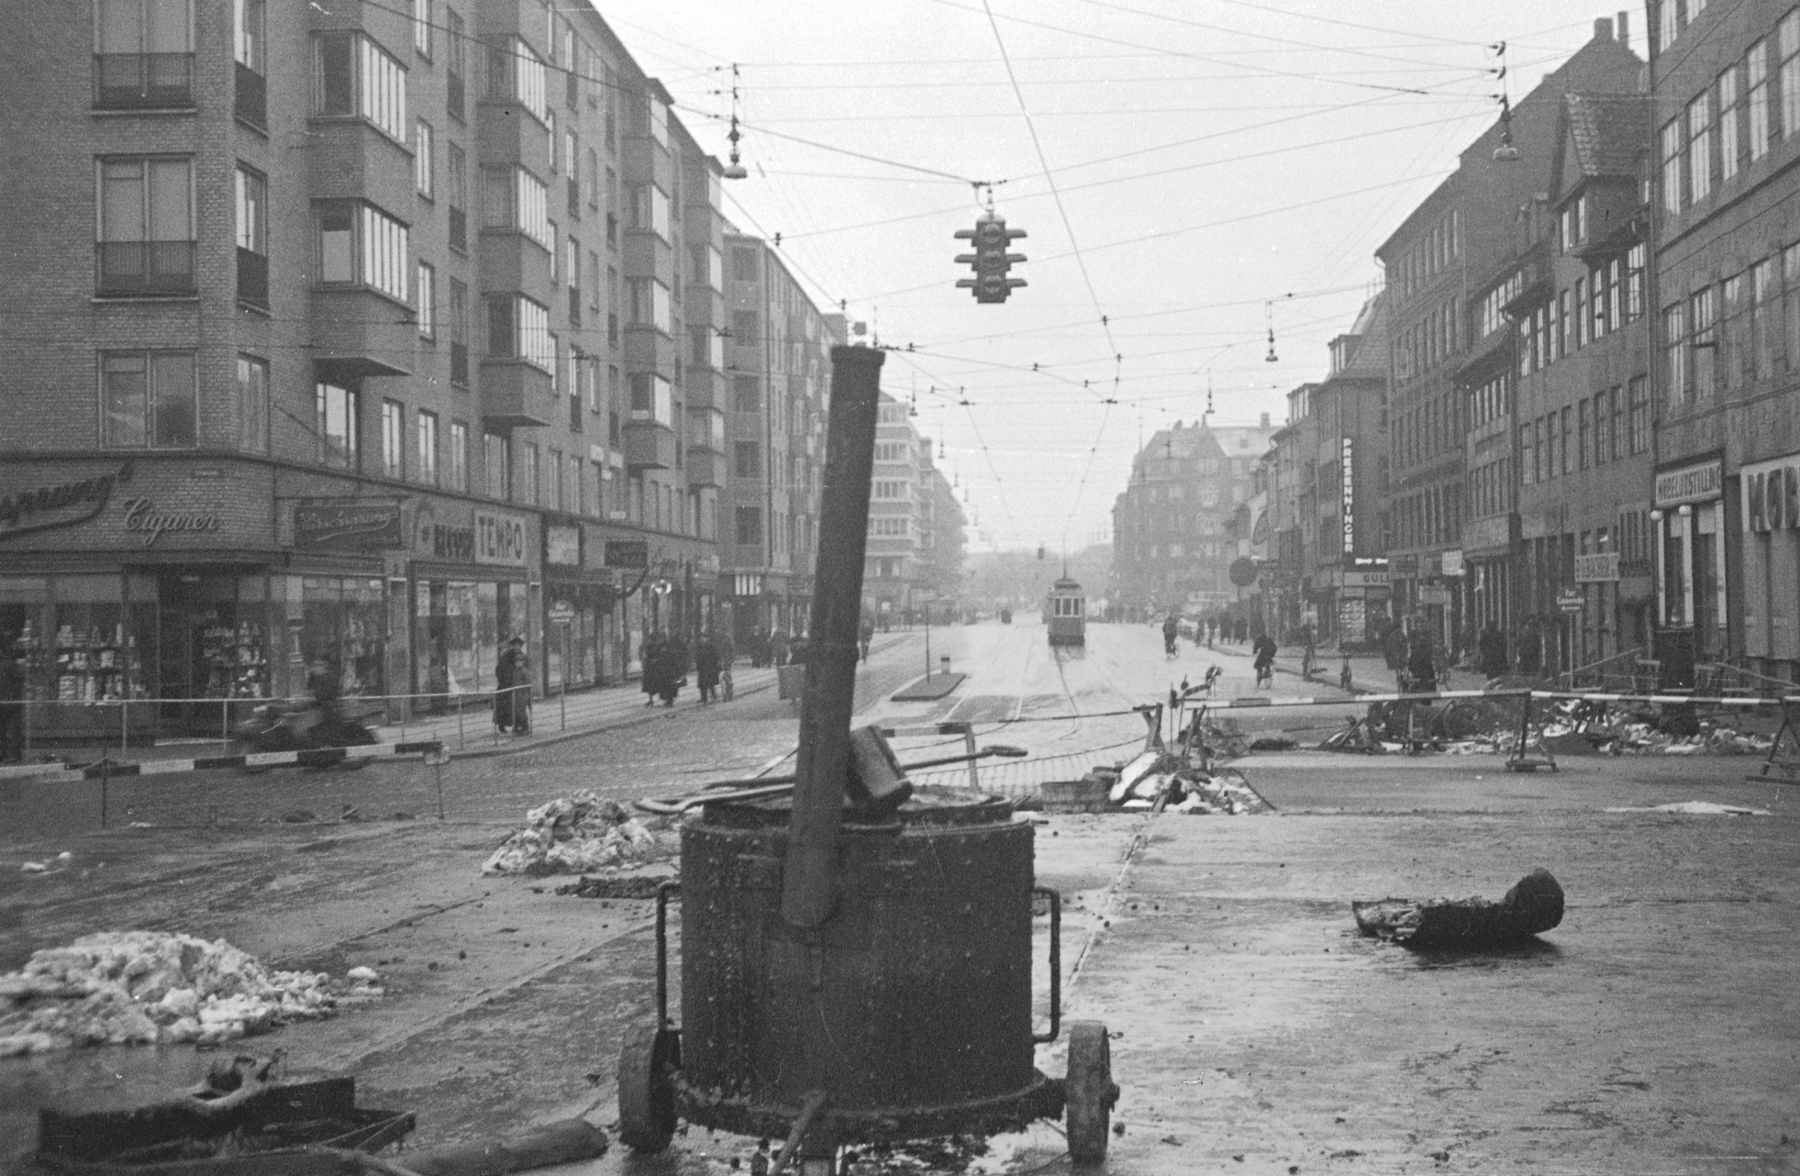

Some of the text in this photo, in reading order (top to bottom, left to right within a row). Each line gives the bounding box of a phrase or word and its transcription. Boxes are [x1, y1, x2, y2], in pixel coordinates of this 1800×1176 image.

[124, 495, 215, 545] Cigarer
[1343, 438, 1353, 552] PRESENNINGER
[478, 516, 522, 559] TEMPO
